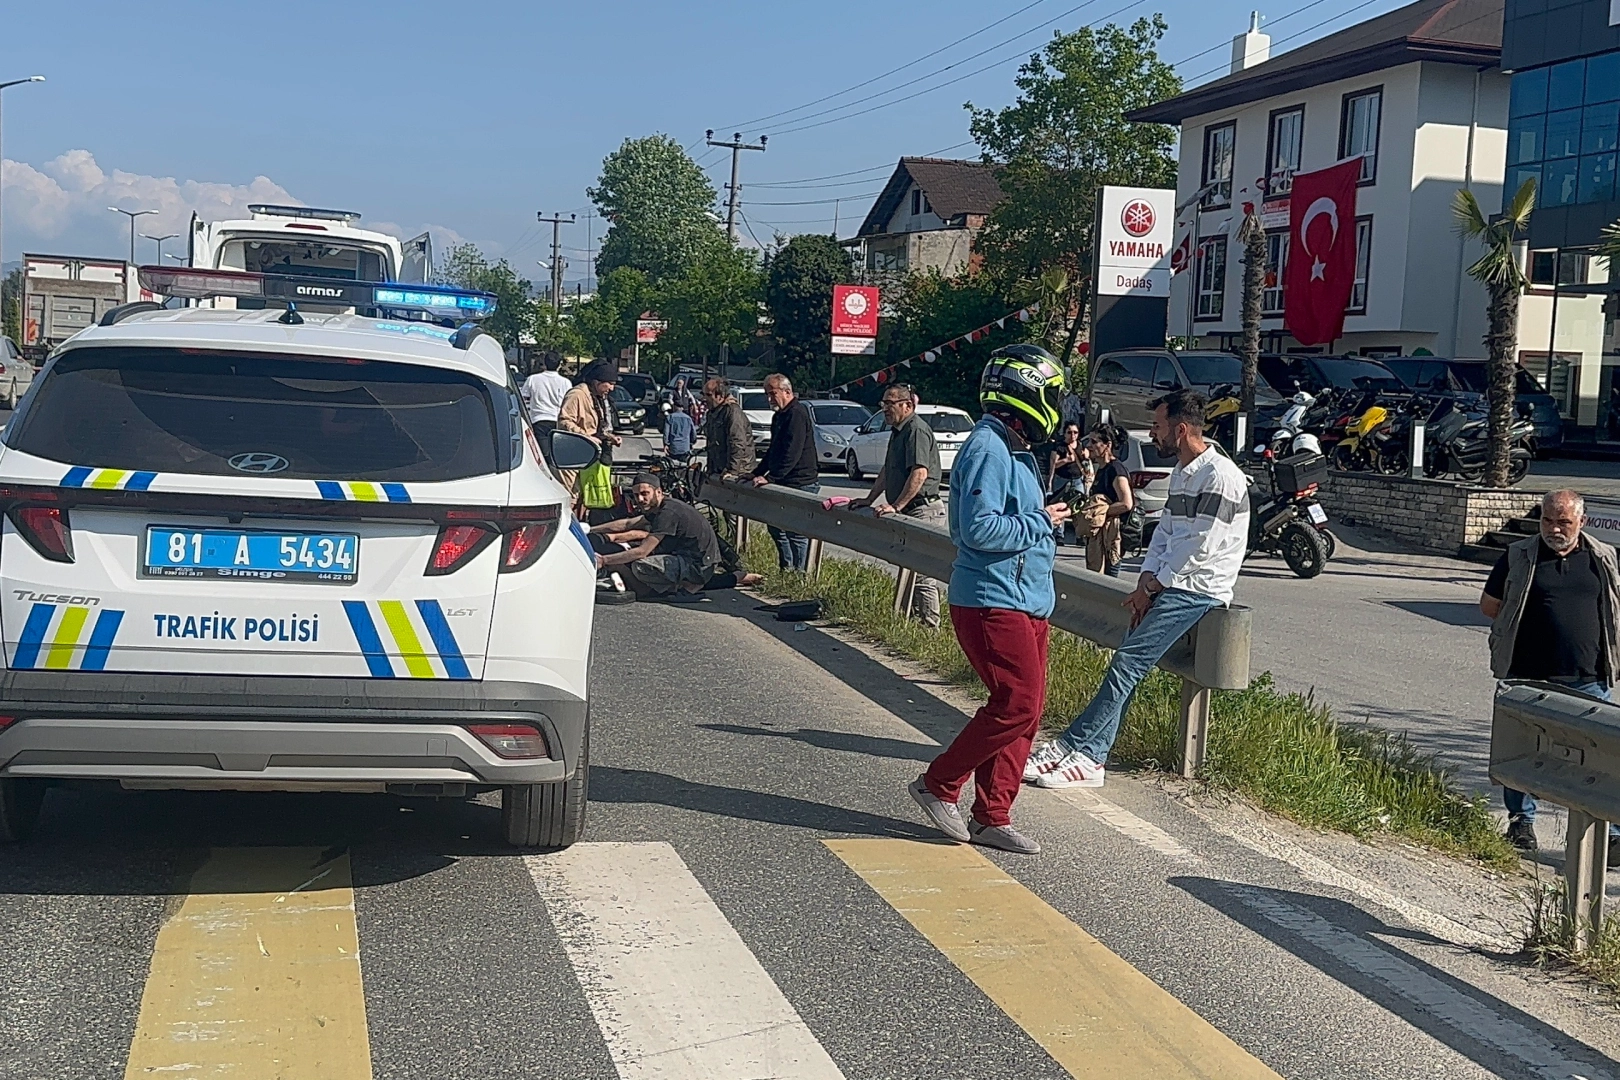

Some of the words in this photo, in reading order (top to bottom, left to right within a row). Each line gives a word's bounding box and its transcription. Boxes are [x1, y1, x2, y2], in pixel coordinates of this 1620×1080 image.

[1109, 240, 1164, 258] YAMAHA
[296, 286, 344, 297] armas
[1116, 274, 1153, 292] Dadaş
[1023, 370, 1044, 385] Arai
[168, 532, 202, 564] 81
[233, 535, 250, 566] A
[279, 536, 352, 570] 5434
[217, 568, 287, 579] Simge
[153, 611, 237, 640] TRAFİK
[244, 613, 319, 642] POLİSİ
